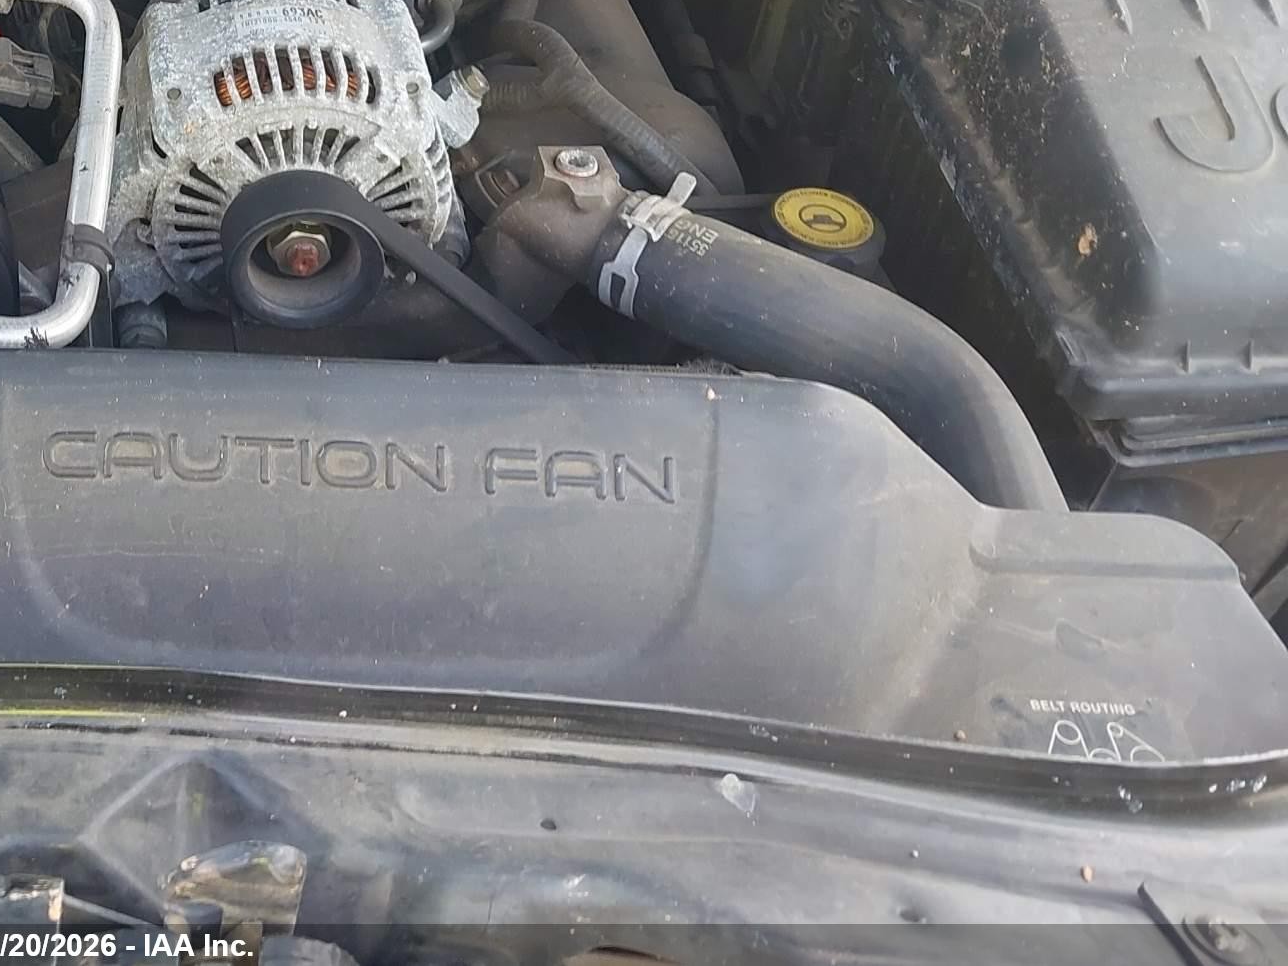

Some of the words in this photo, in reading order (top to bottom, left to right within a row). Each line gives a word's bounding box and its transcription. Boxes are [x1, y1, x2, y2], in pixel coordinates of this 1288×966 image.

[42, 431, 448, 493] CAUTION
[483, 447, 676, 505] FAN
[1030, 698, 1065, 713] BELT
[1069, 700, 1136, 715] ROUTING
